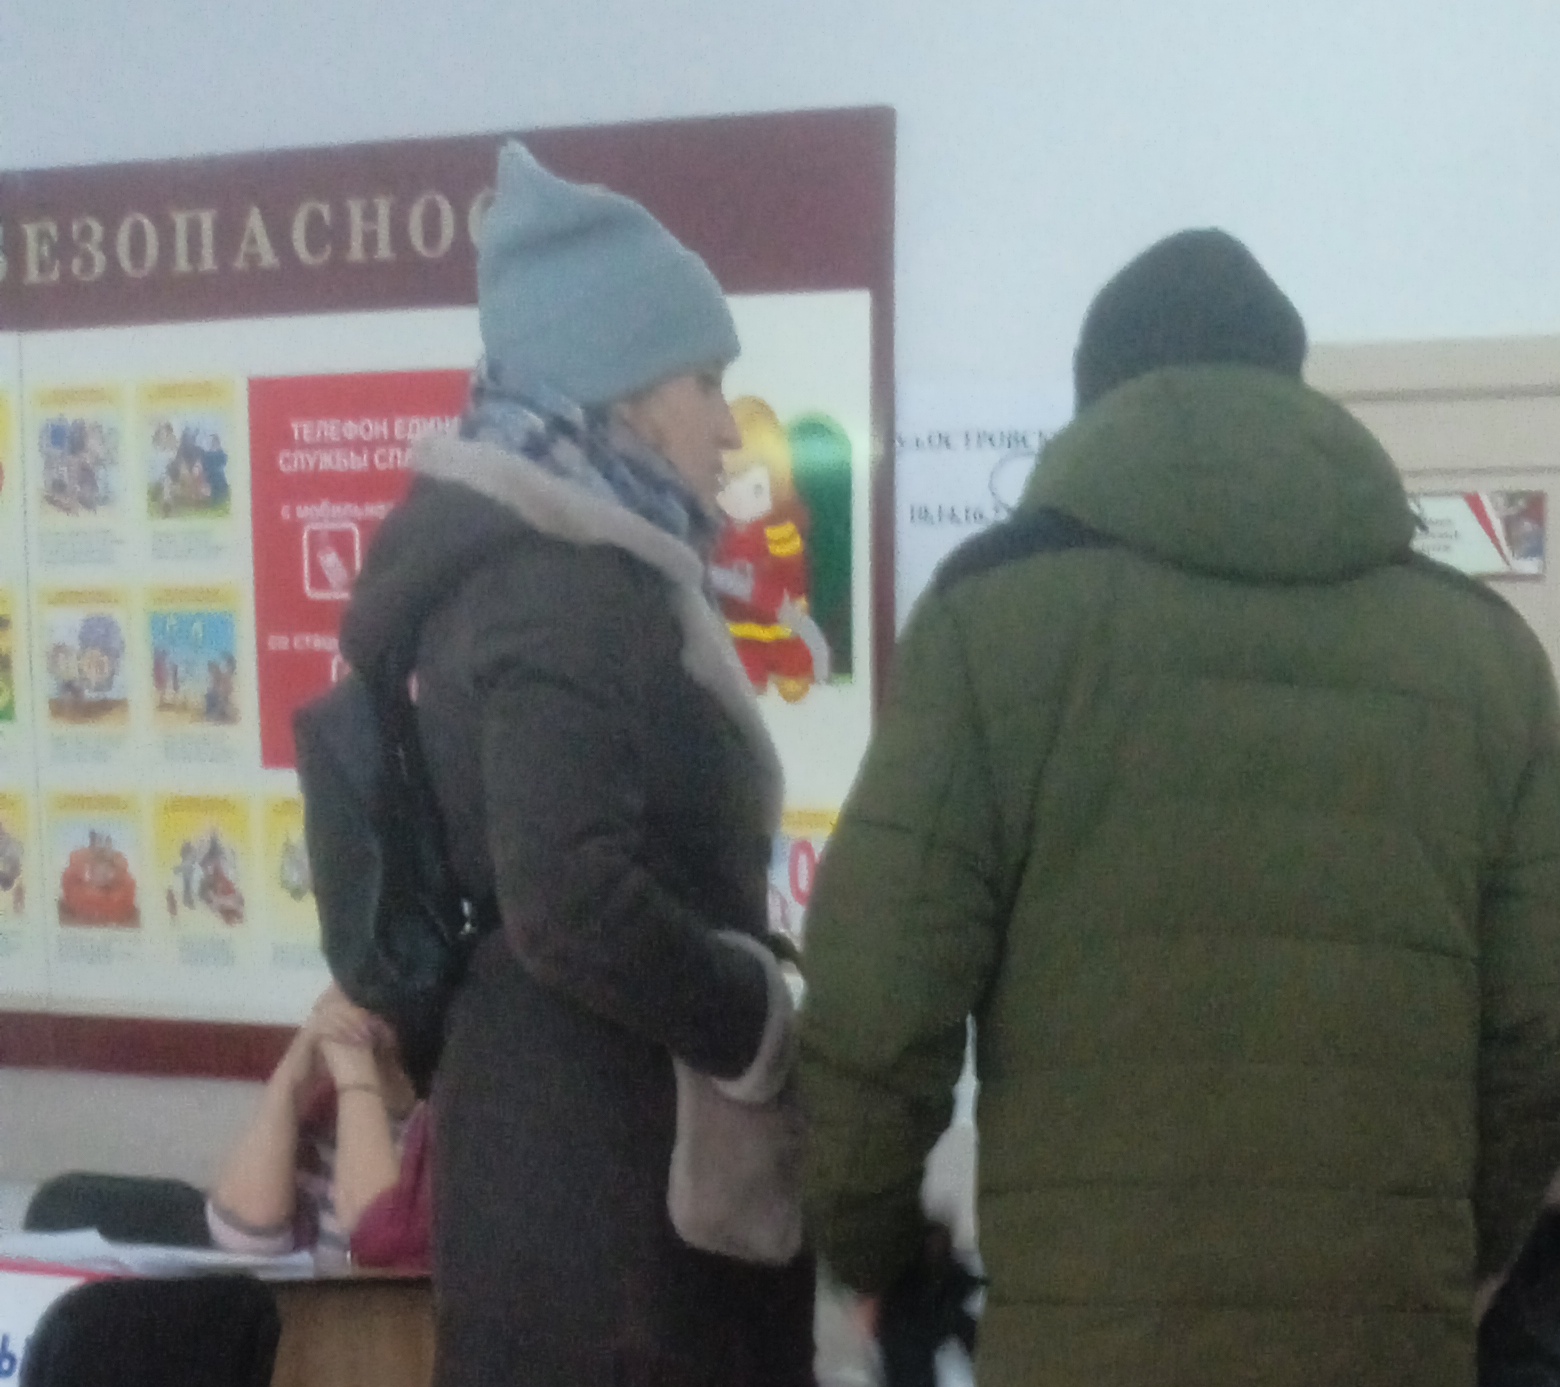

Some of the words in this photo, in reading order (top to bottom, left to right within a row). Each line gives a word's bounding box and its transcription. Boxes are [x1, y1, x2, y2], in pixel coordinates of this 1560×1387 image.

[0, 190, 500, 286] ЕЗОПАСНО
[291, 418, 389, 441] ТЕЛЕФОН
[278, 448, 368, 473] СЛУЖБЫ
